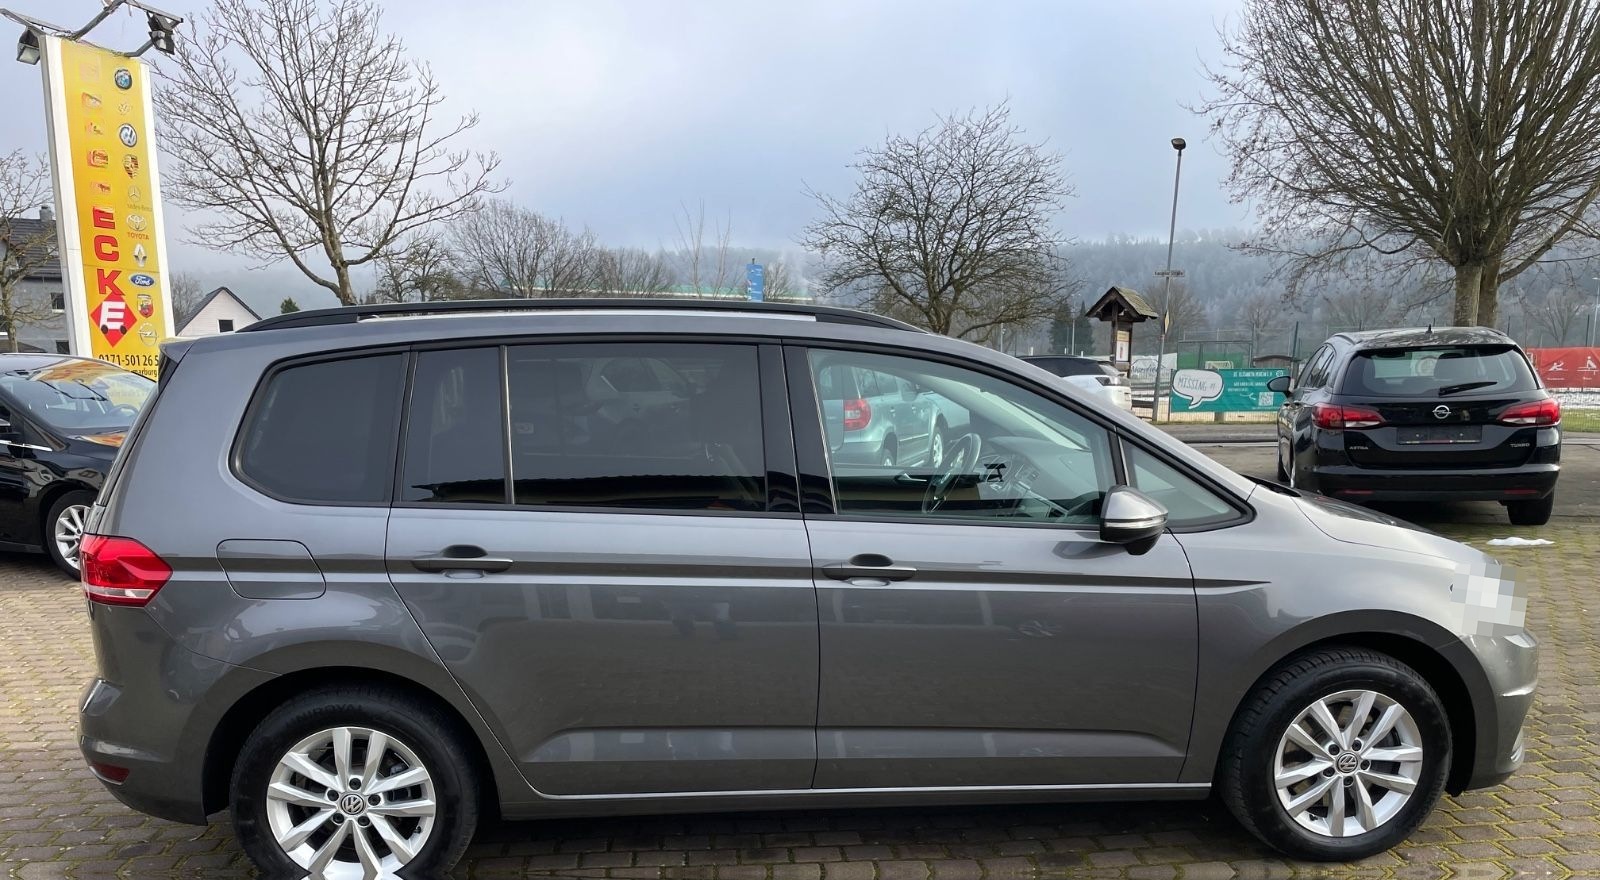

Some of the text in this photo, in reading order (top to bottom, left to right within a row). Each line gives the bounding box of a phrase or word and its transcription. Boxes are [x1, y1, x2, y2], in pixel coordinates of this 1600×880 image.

[127, 231, 150, 240] TOYOTA
[134, 275, 151, 286] Ford
[143, 354, 153, 366] 26
[1177, 375, 1207, 391] MISSING
